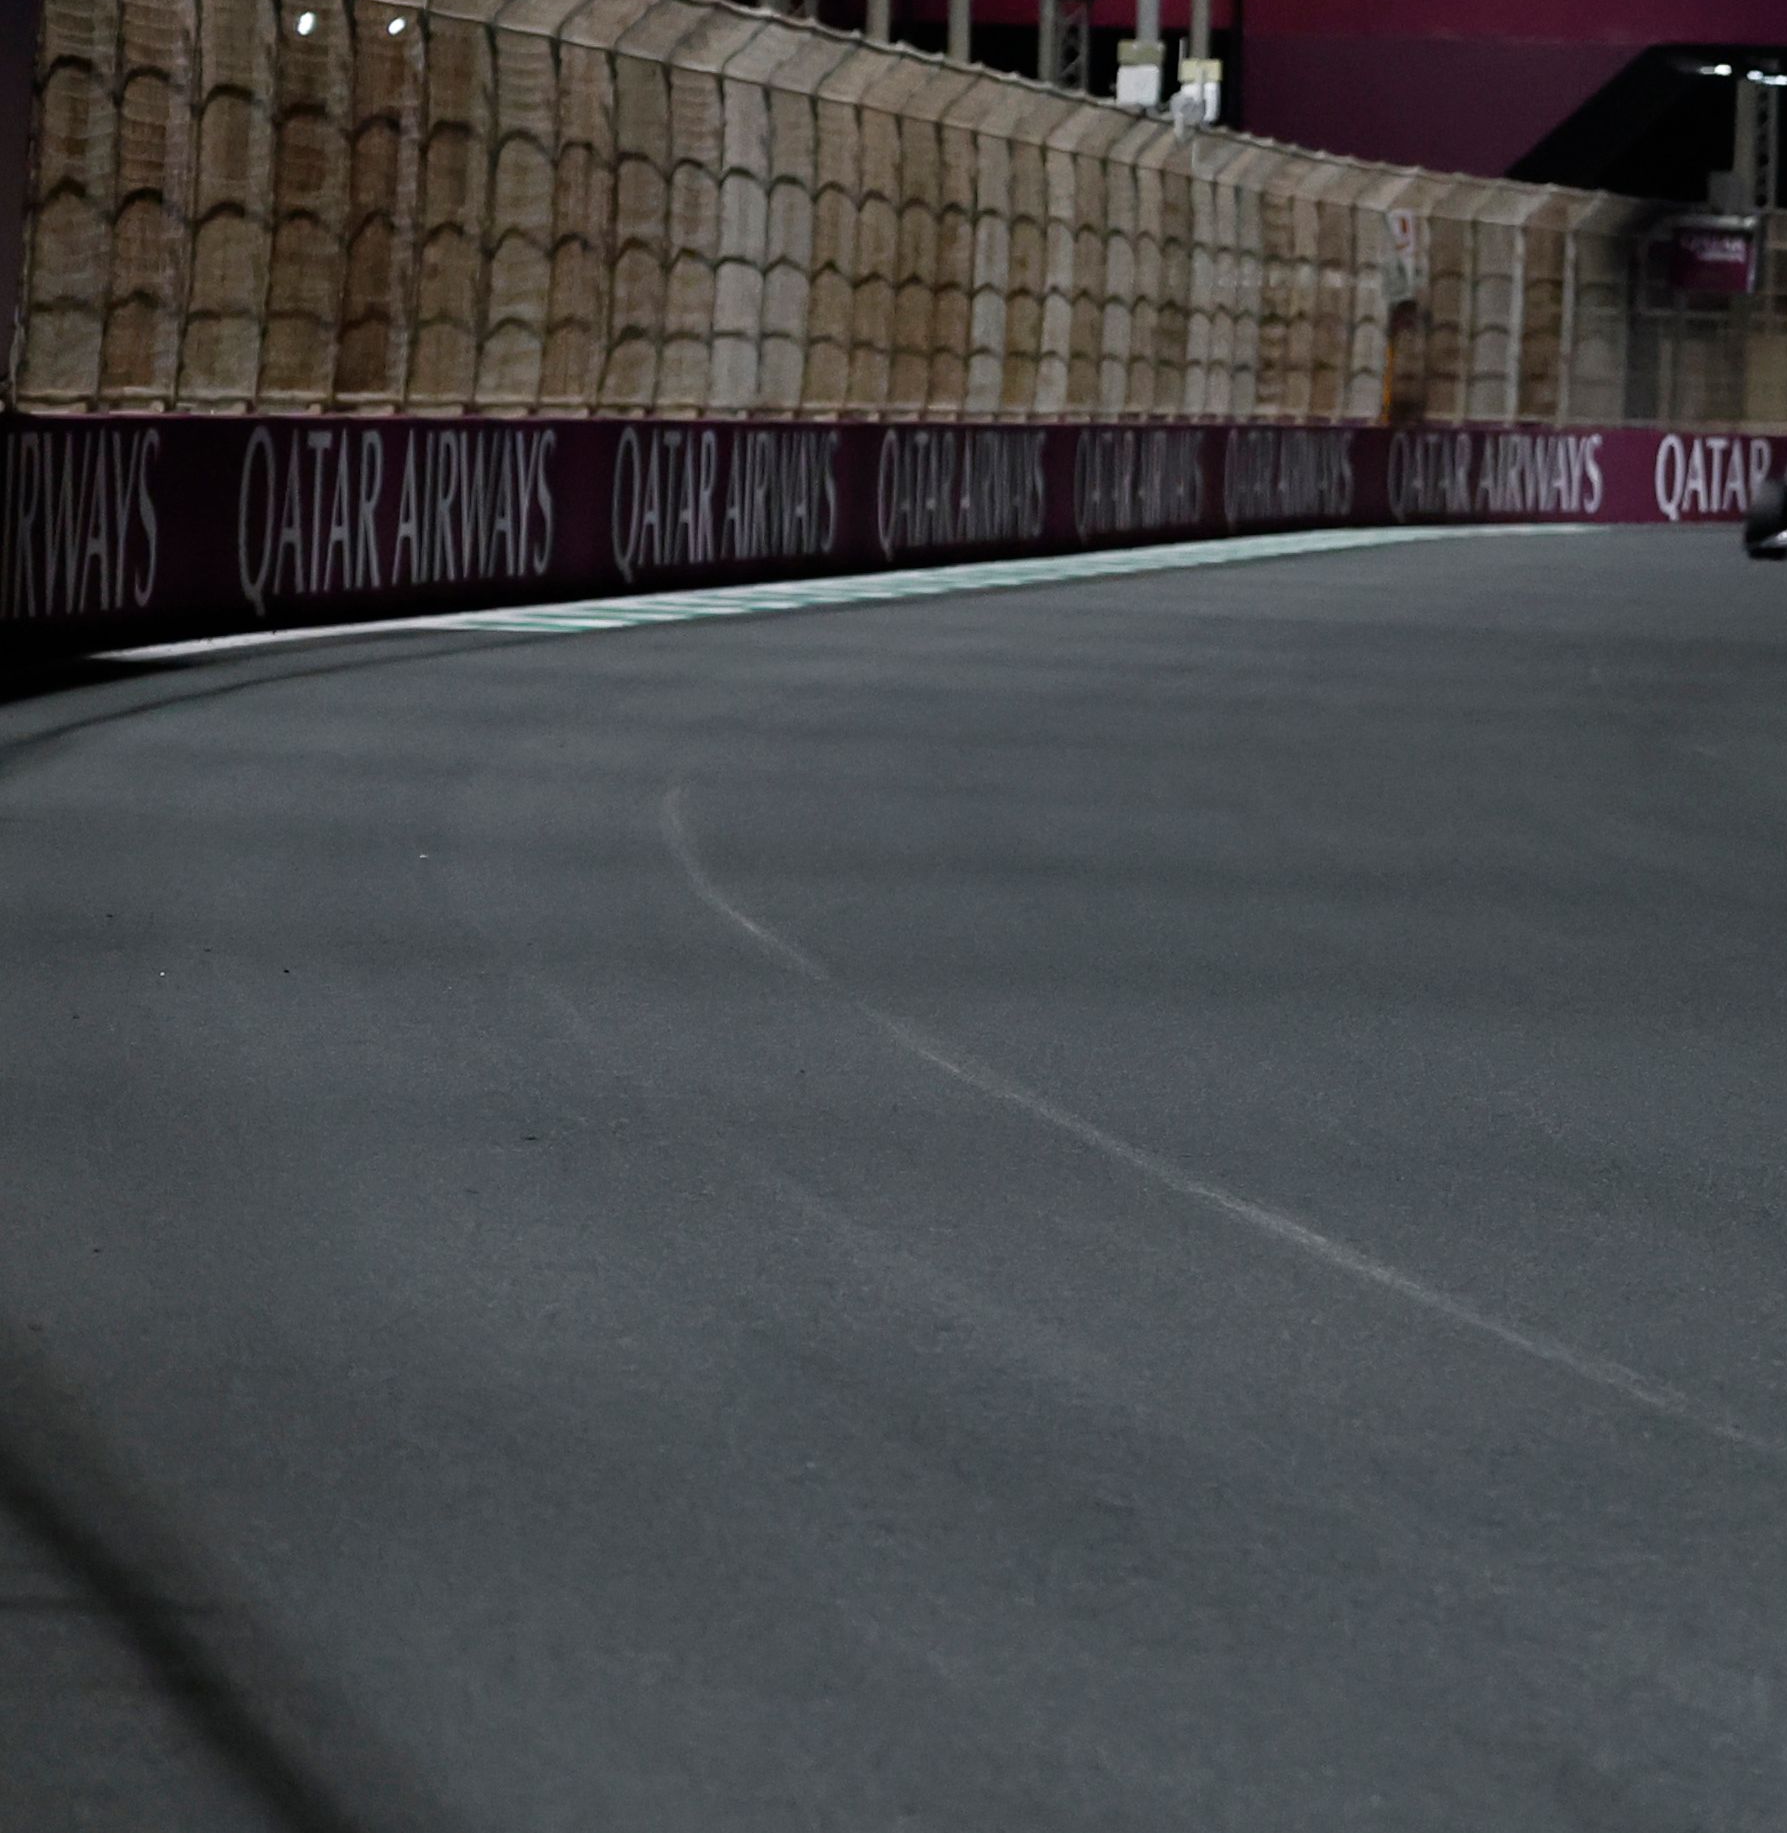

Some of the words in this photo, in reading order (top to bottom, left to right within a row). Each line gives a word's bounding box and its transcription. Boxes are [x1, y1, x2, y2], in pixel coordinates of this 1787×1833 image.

[237, 424, 386, 618] QATAR
[390, 427, 559, 585] AIRWAYS
[610, 425, 720, 585] QATAR
[1477, 433, 1603, 516] AIRWAYS
[1654, 433, 1773, 522] QATAR
